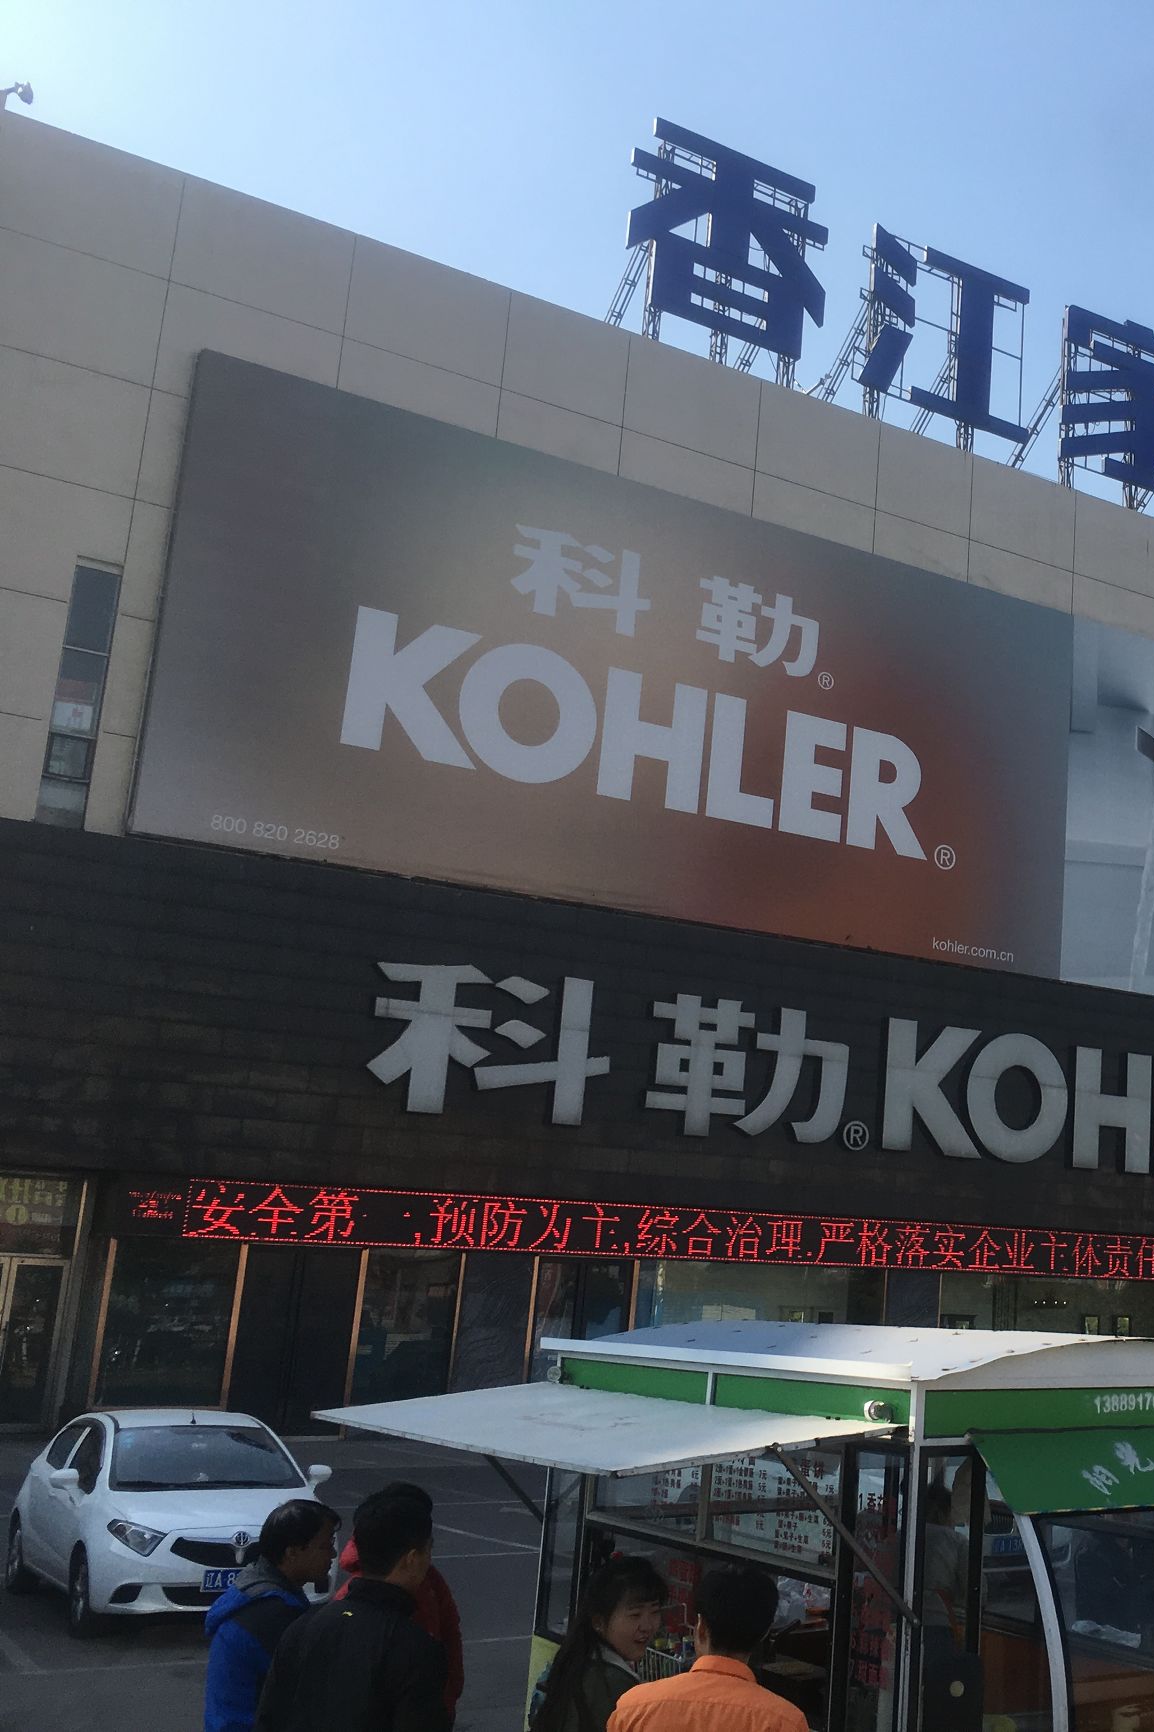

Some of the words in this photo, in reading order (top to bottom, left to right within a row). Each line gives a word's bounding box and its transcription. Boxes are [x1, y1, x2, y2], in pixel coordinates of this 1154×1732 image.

[510, 523, 819, 677] 科勒
[340, 605, 927, 861] KOHLER
[210, 814, 247, 834] 800
[252, 821, 288, 841] 820
[293, 828, 340, 850] 2628
[932, 936, 1014, 963] kohler.com.cn
[366, 961, 850, 1144] 科勒
